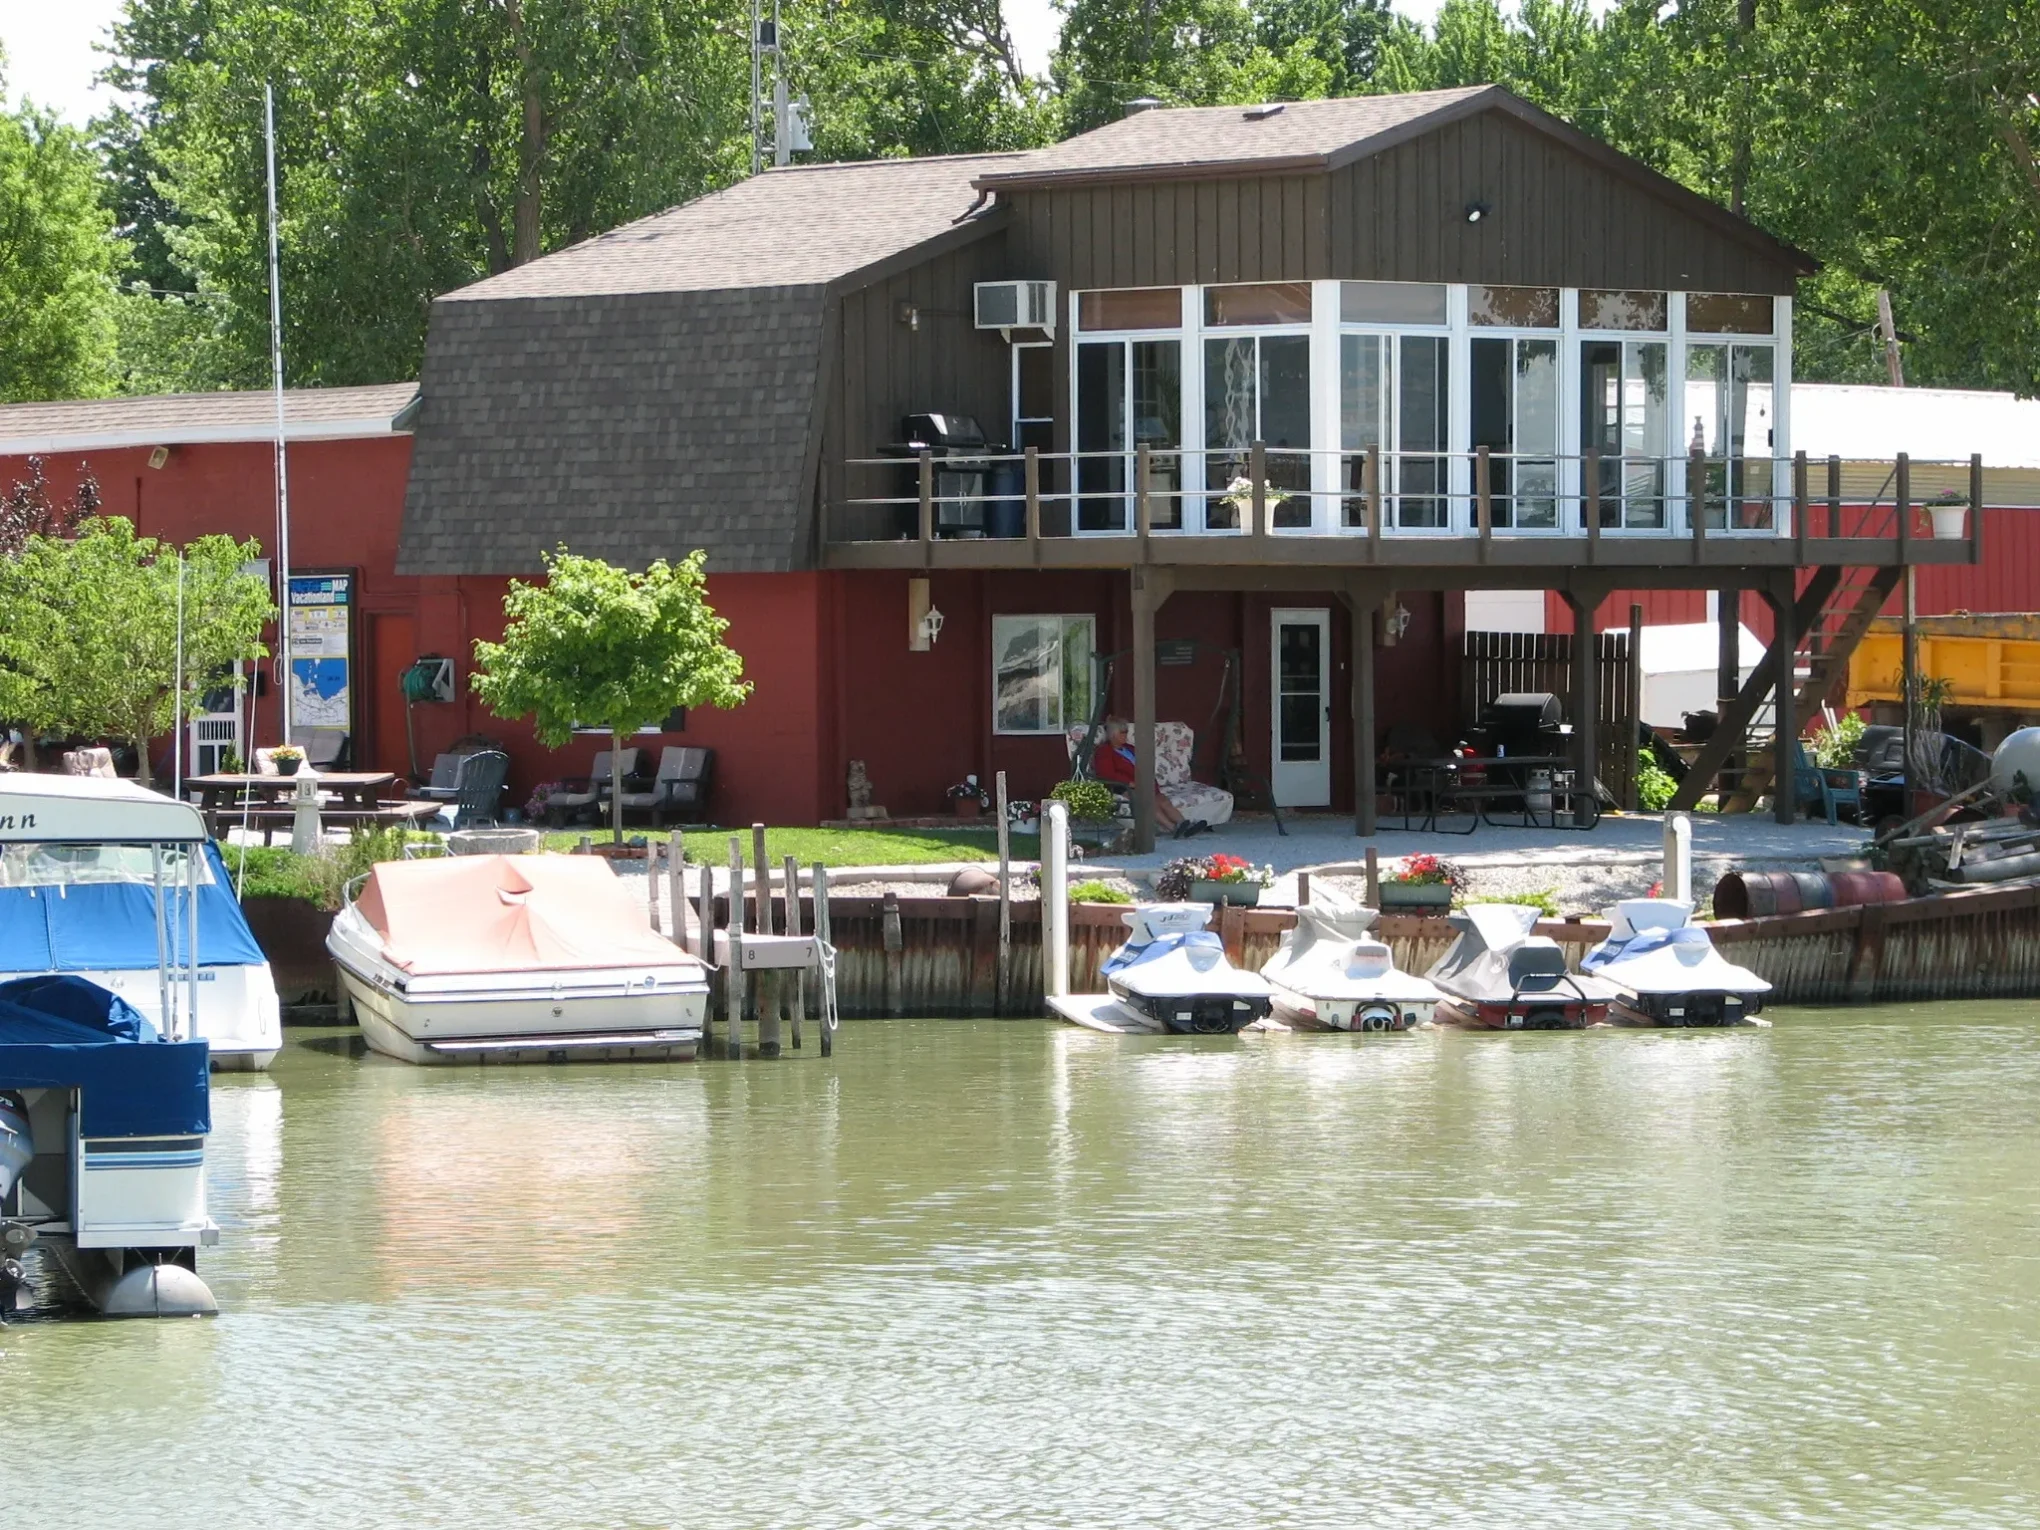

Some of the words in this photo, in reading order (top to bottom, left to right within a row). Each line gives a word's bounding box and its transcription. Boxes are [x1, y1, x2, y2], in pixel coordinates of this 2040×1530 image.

[332, 579, 348, 591] MAP
[291, 592, 335, 604] Vacationland
[749, 950, 756, 960] 8
[806, 947, 813, 958] 7
